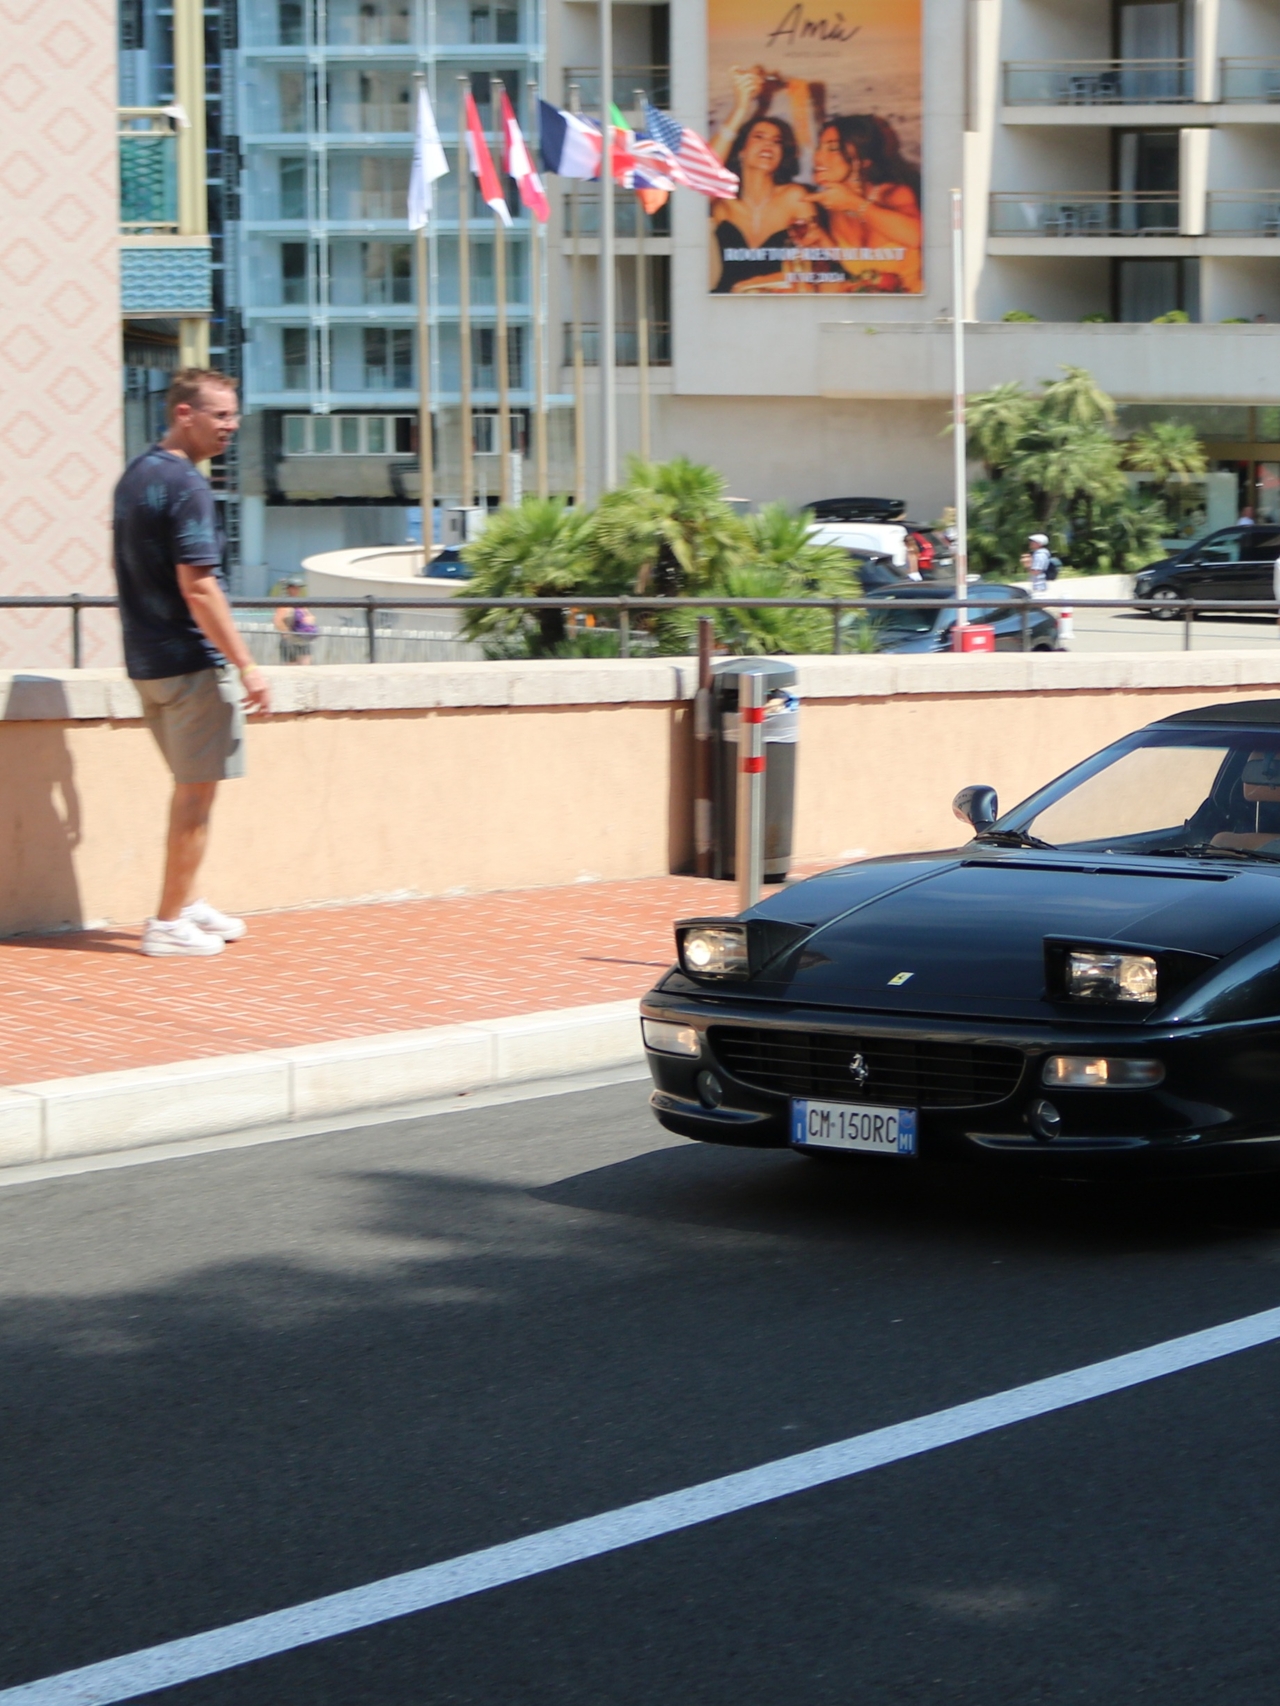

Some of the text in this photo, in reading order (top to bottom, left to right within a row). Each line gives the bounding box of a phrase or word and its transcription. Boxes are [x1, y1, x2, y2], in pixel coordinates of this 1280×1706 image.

[723, 247, 905, 261] ROOFTOP RESTAURANT
[900, 1133, 912, 1150] MI
